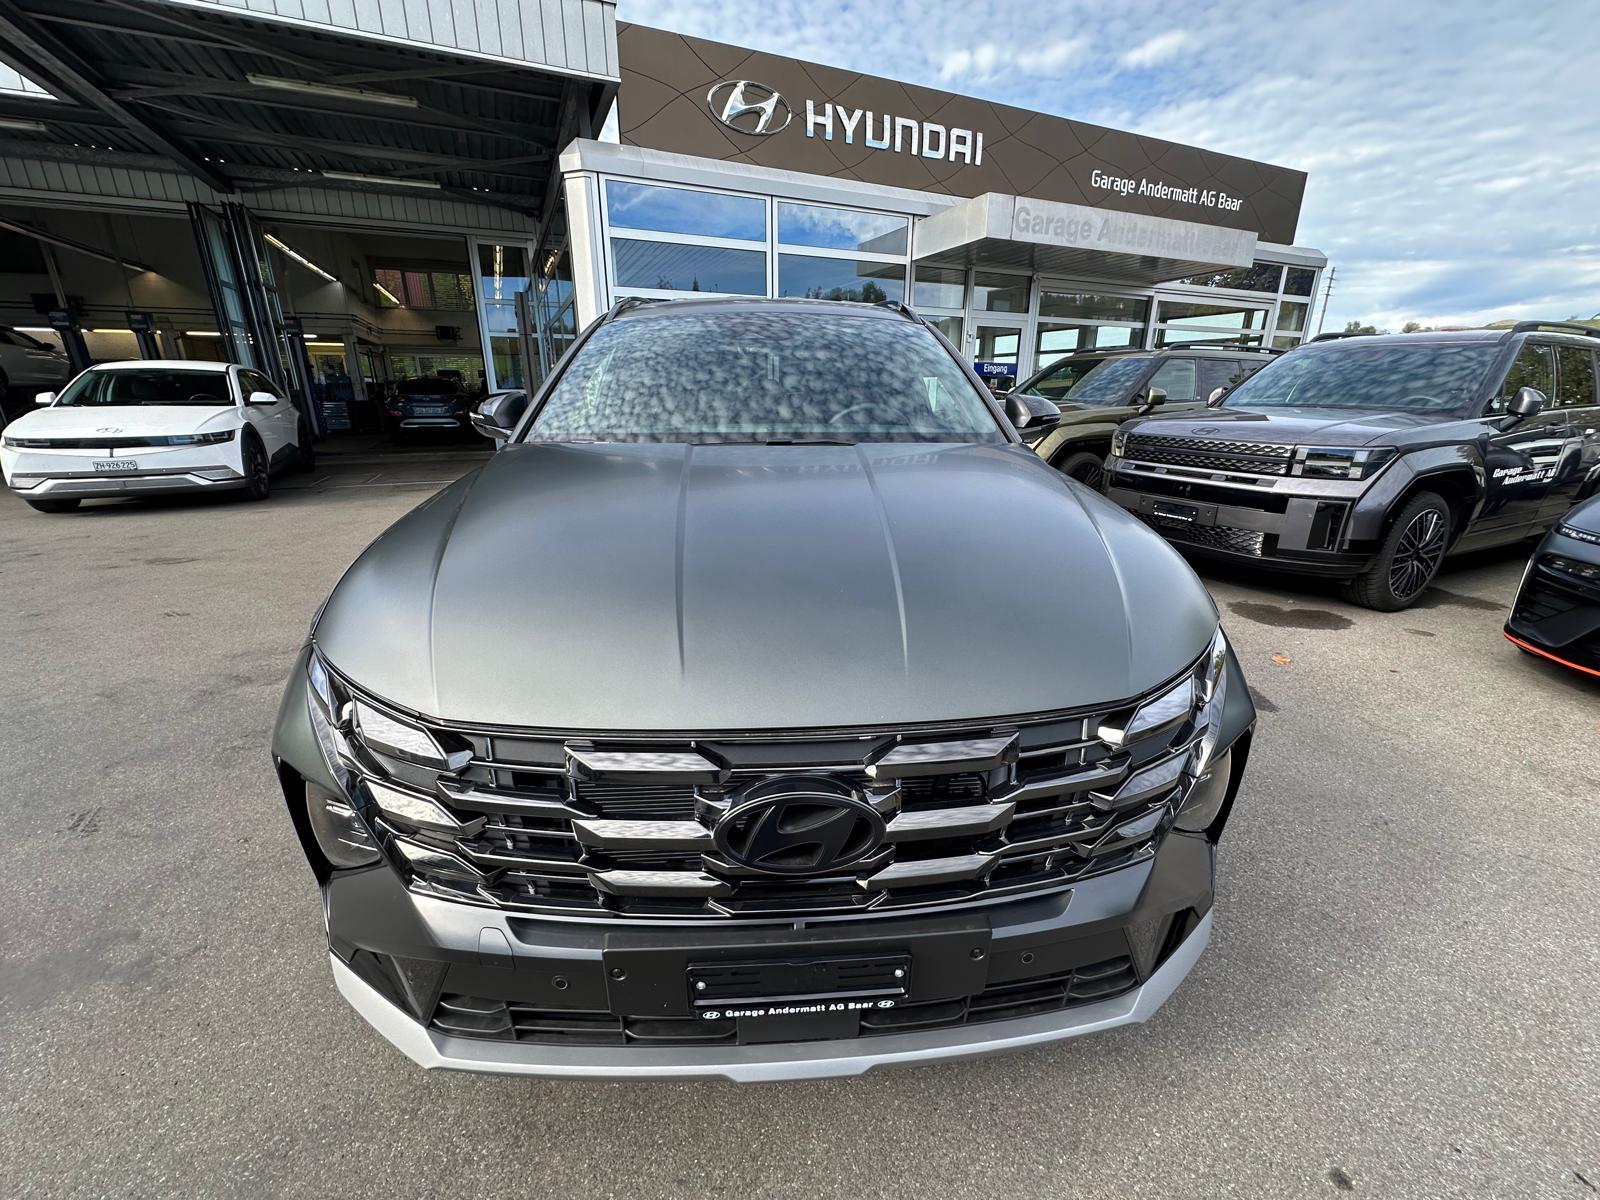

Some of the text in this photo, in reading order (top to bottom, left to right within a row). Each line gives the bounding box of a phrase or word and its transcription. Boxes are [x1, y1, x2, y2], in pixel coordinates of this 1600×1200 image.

[805, 99, 984, 166] HYUNDAI
[1091, 169, 1243, 211] Garage Andermatt AG Baar
[1014, 206, 1093, 243] Garage
[983, 363, 1008, 375] Eingang
[1492, 466, 1524, 478] Garage
[1502, 470, 1545, 486] Andermatt
[724, 1001, 874, 1018] Garage Andermatt AG Baar
